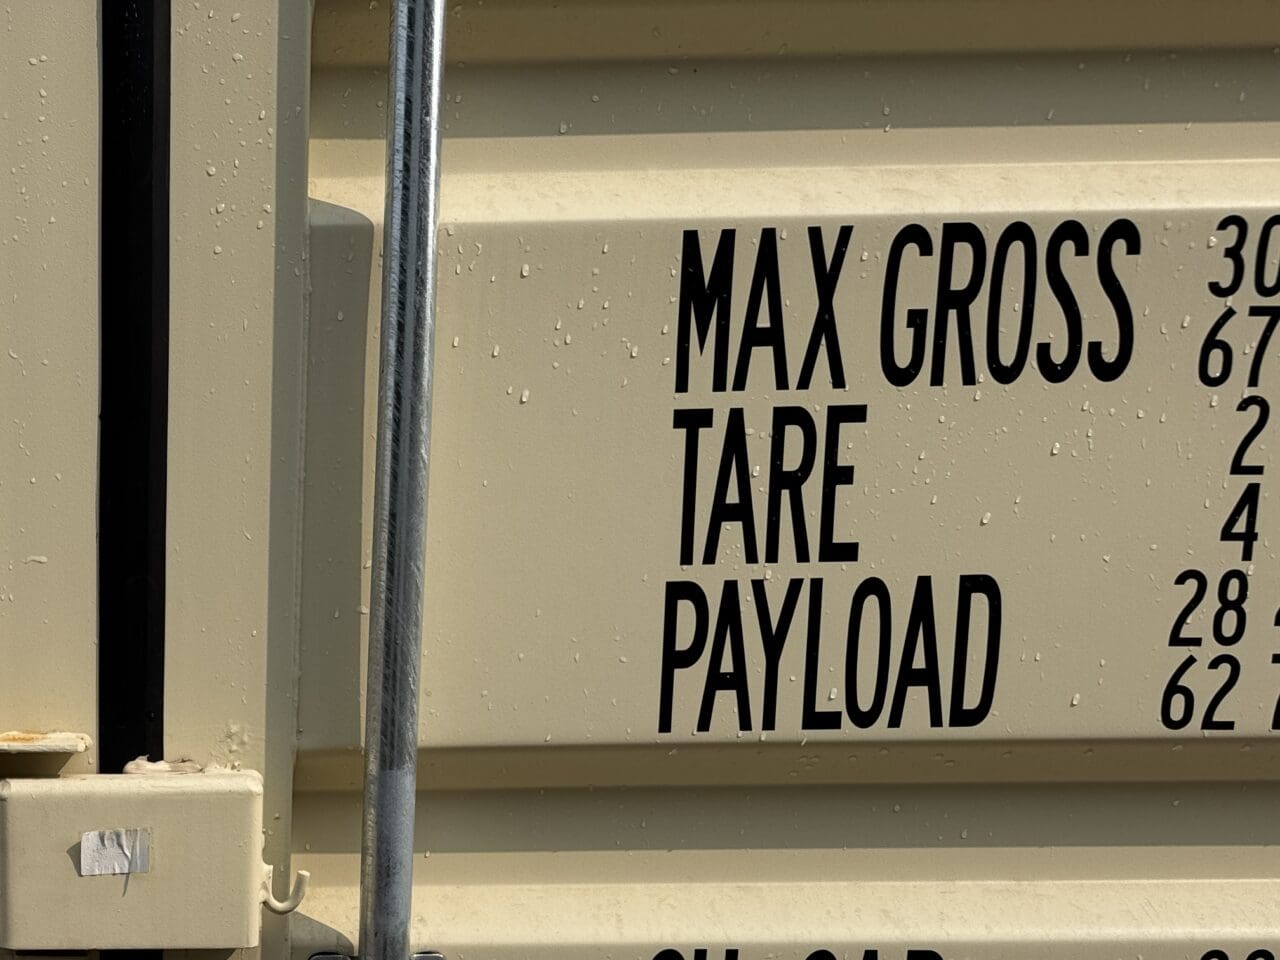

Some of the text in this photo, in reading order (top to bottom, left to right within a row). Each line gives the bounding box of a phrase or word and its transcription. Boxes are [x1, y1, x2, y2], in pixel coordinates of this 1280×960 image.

[675, 215, 1280, 393] MAX GROSS 30
[1198, 306, 1280, 387] 67
[673, 395, 1270, 565] TARE 2
[1220, 483, 1261, 561] 4
[658, 569, 1248, 733] PAYLOAD 28
[1161, 654, 1241, 730] 62
